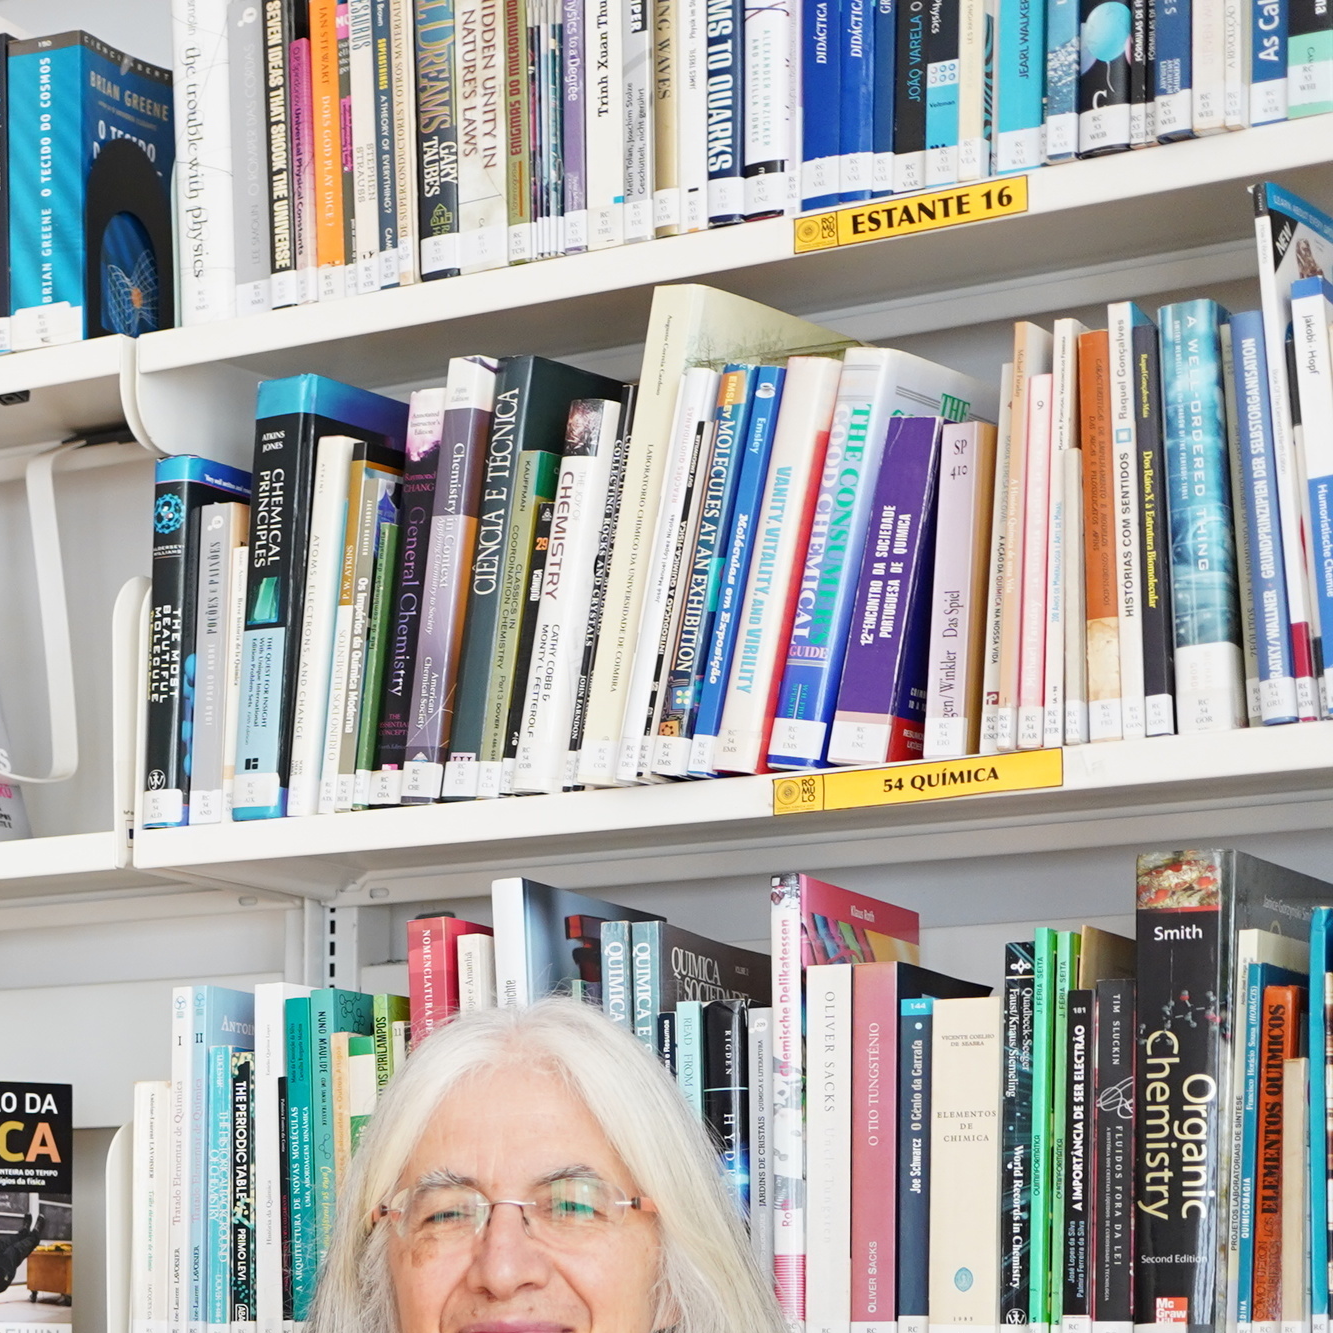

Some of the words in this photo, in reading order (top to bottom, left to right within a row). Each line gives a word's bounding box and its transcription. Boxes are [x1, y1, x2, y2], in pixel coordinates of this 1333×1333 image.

[266, 1, 282, 42] SEVEN
[184, 46, 201, 77] the
[267, 45, 283, 79] IDEAS
[708, 38, 733, 69] TO
[40, 57, 51, 108] COSMOS
[269, 81, 284, 119] THAT
[40, 114, 51, 130] DO
[187, 84, 203, 155] trouble
[708, 71, 734, 173] QUARKS
[41, 137, 51, 184] TECIDO
[270, 122, 286, 167] SHOOK
[422, 136, 440, 198] TAUBES
[438, 140, 458, 184] GARY
[41, 187, 51, 197] O
[185, 158, 205, 200] with
[271, 169, 287, 196] THE
[42, 207, 52, 256] GREENE
[852, 193, 971, 235] ESTANTE
[979, 186, 1013, 210] 16
[186, 206, 208, 279] physics
[273, 200, 290, 270] UNIVERSE
[42, 263, 52, 303] BRIAN
[721, 375, 738, 420] EMSLEY
[261, 430, 286, 442] ATKINS
[262, 441, 284, 453] JONES
[486, 388, 520, 485] TÉCNICA
[749, 417, 766, 456] Emsley
[953, 438, 968, 456] SP
[444, 442, 465, 518] Chemistry
[520, 460, 532, 512] KAUFFMAN
[703, 420, 734, 519] MOLECULES
[1120, 452, 1131, 518] SENTIDOS
[267, 468, 285, 566] CHEMICAL
[767, 466, 792, 524] VANITY,
[253, 470, 271, 569] PRINCIPLES
[544, 470, 575, 601] CHEMISTRY
[876, 504, 897, 558] SOCIEDADE
[398, 505, 426, 589] General
[473, 508, 505, 597] CIÊNCIA
[727, 513, 749, 586] Moléculas
[753, 523, 781, 597] VITALITY,
[879, 580, 900, 638] PORTUGUESA
[894, 513, 912, 555] QUIMICA
[1124, 551, 1134, 618] HISTÓRIAS
[172, 607, 182, 643] THE
[676, 572, 709, 673] EXHIBITION
[748, 600, 763, 626] AND
[947, 589, 960, 619] Spiel
[388, 591, 417, 698] Chemistry
[709, 610, 730, 684] Exposição
[788, 646, 829, 659] GUIDE
[943, 620, 959, 638] Das
[151, 606, 164, 703] MOLECULE
[159, 604, 172, 704] BEAUTIFUL
[735, 627, 763, 695] VIRILITY
[883, 778, 904, 793] 54
[910, 766, 1000, 791] QUÍMICA
[1154, 923, 1203, 941] Smith
[778, 918, 790, 995] Delikatessen
[824, 991, 835, 1054] OLIVER
[910, 1002, 926, 1010] 144
[723, 1029, 732, 1076] RIGDEN
[866, 1022, 880, 1107] TUNGSTÉNIO
[1072, 1024, 1085, 1082] ELECTRÃO
[25, 1093, 58, 1114] DA
[824, 1060, 835, 1113] SACKS
[235, 1107, 250, 1164] PERIODIC
[867, 1108, 879, 1133] TIO
[936, 1109, 997, 1119] ELEMENTOS
[943, 1133, 990, 1142] CHIMICA
[959, 1122, 973, 1130] DE
[1136, 1029, 1180, 1221] Chemistry
[910, 1138, 921, 1176] Schwarcz
[1012, 1145, 1024, 1178] World
[1071, 1125, 1084, 1201] IMPORTÂNCIA
[1172, 1073, 1217, 1220] Organic
[1262, 1102, 1282, 1215] ELEMENTOS
[35, 1169, 58, 1177] TEMPO
[235, 1165, 248, 1199] TABLE
[910, 1176, 921, 1193] Joe
[1012, 1180, 1024, 1223] Records
[1241, 1177, 1251, 1238] QUIMICOMAGIA
[237, 1227, 247, 1260] PRIMO
[868, 1241, 878, 1275] SACKS
[1011, 1239, 1023, 1290] Chemistry
[1141, 1253, 1172, 1264] Second
[1174, 1253, 1208, 1264] Edition
[238, 1262, 247, 1281] LEVI
[868, 1277, 877, 1313] OLIVER
